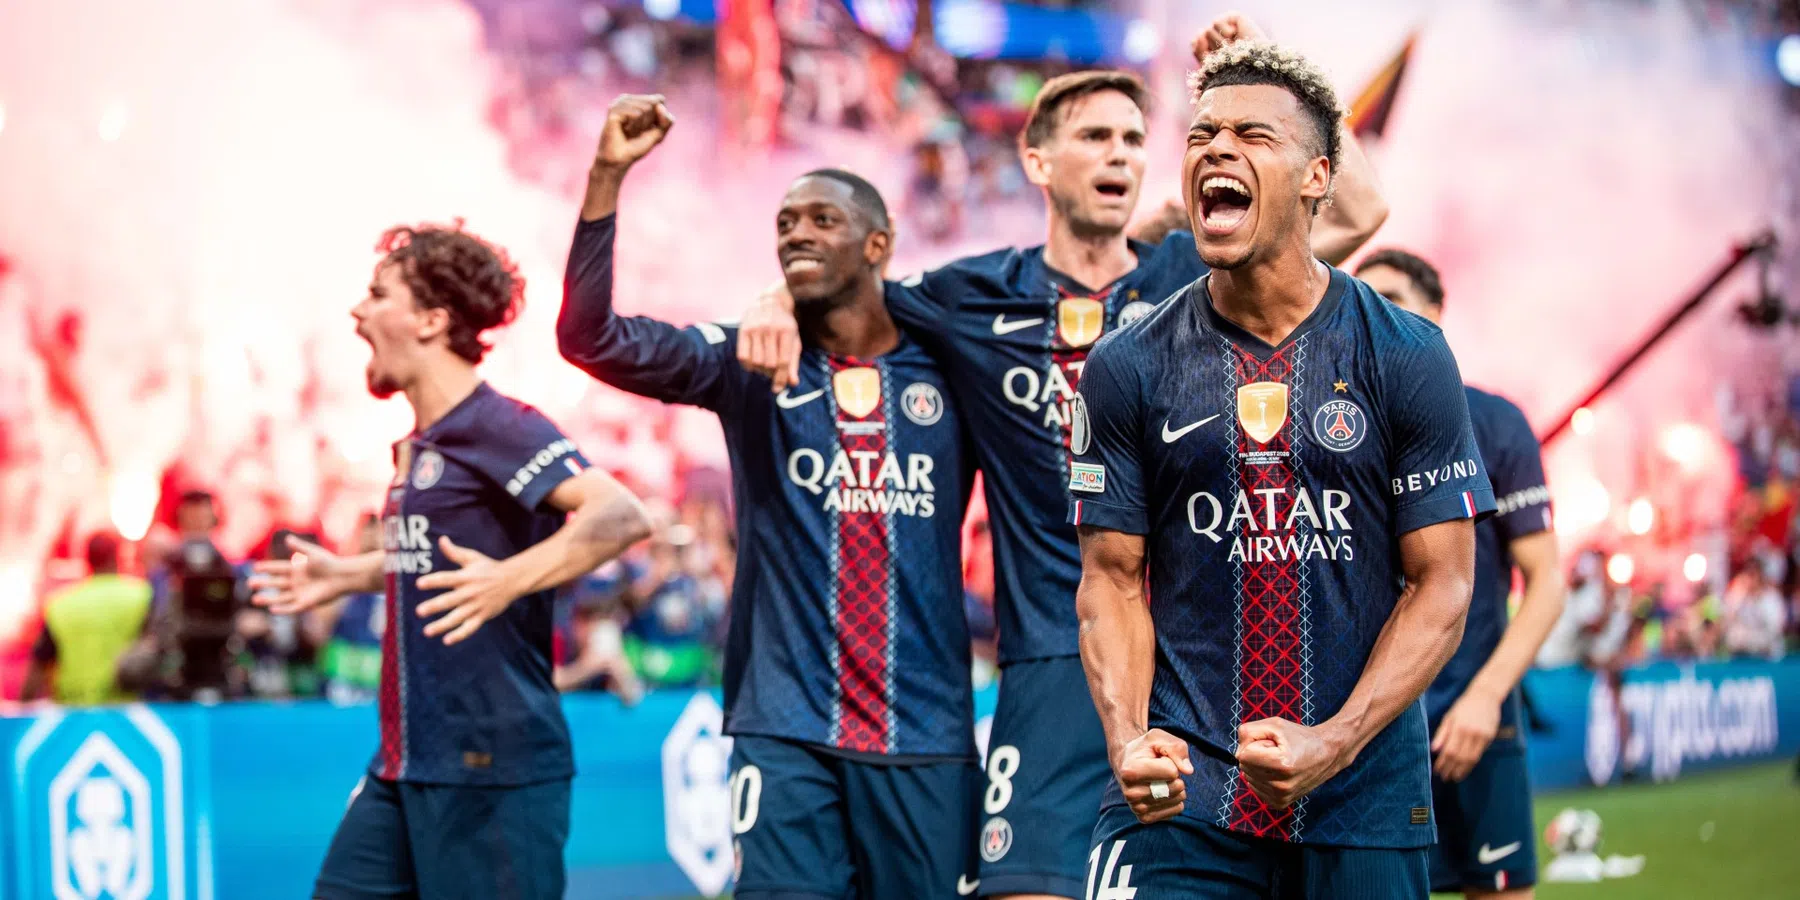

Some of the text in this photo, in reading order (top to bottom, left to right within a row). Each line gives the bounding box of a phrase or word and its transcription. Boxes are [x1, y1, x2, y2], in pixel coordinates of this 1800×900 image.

[1323, 403, 1357, 416] PARIS
[787, 447, 935, 495] QATAR
[1392, 459, 1477, 495] BEYOND
[823, 487, 935, 518] AIRWAYS
[1187, 487, 1353, 543] QATAR
[1227, 534, 1354, 562] AIRWAYS
[730, 765, 762, 834] 0
[984, 745, 1020, 814] 8
[1086, 840, 1137, 900] 14
